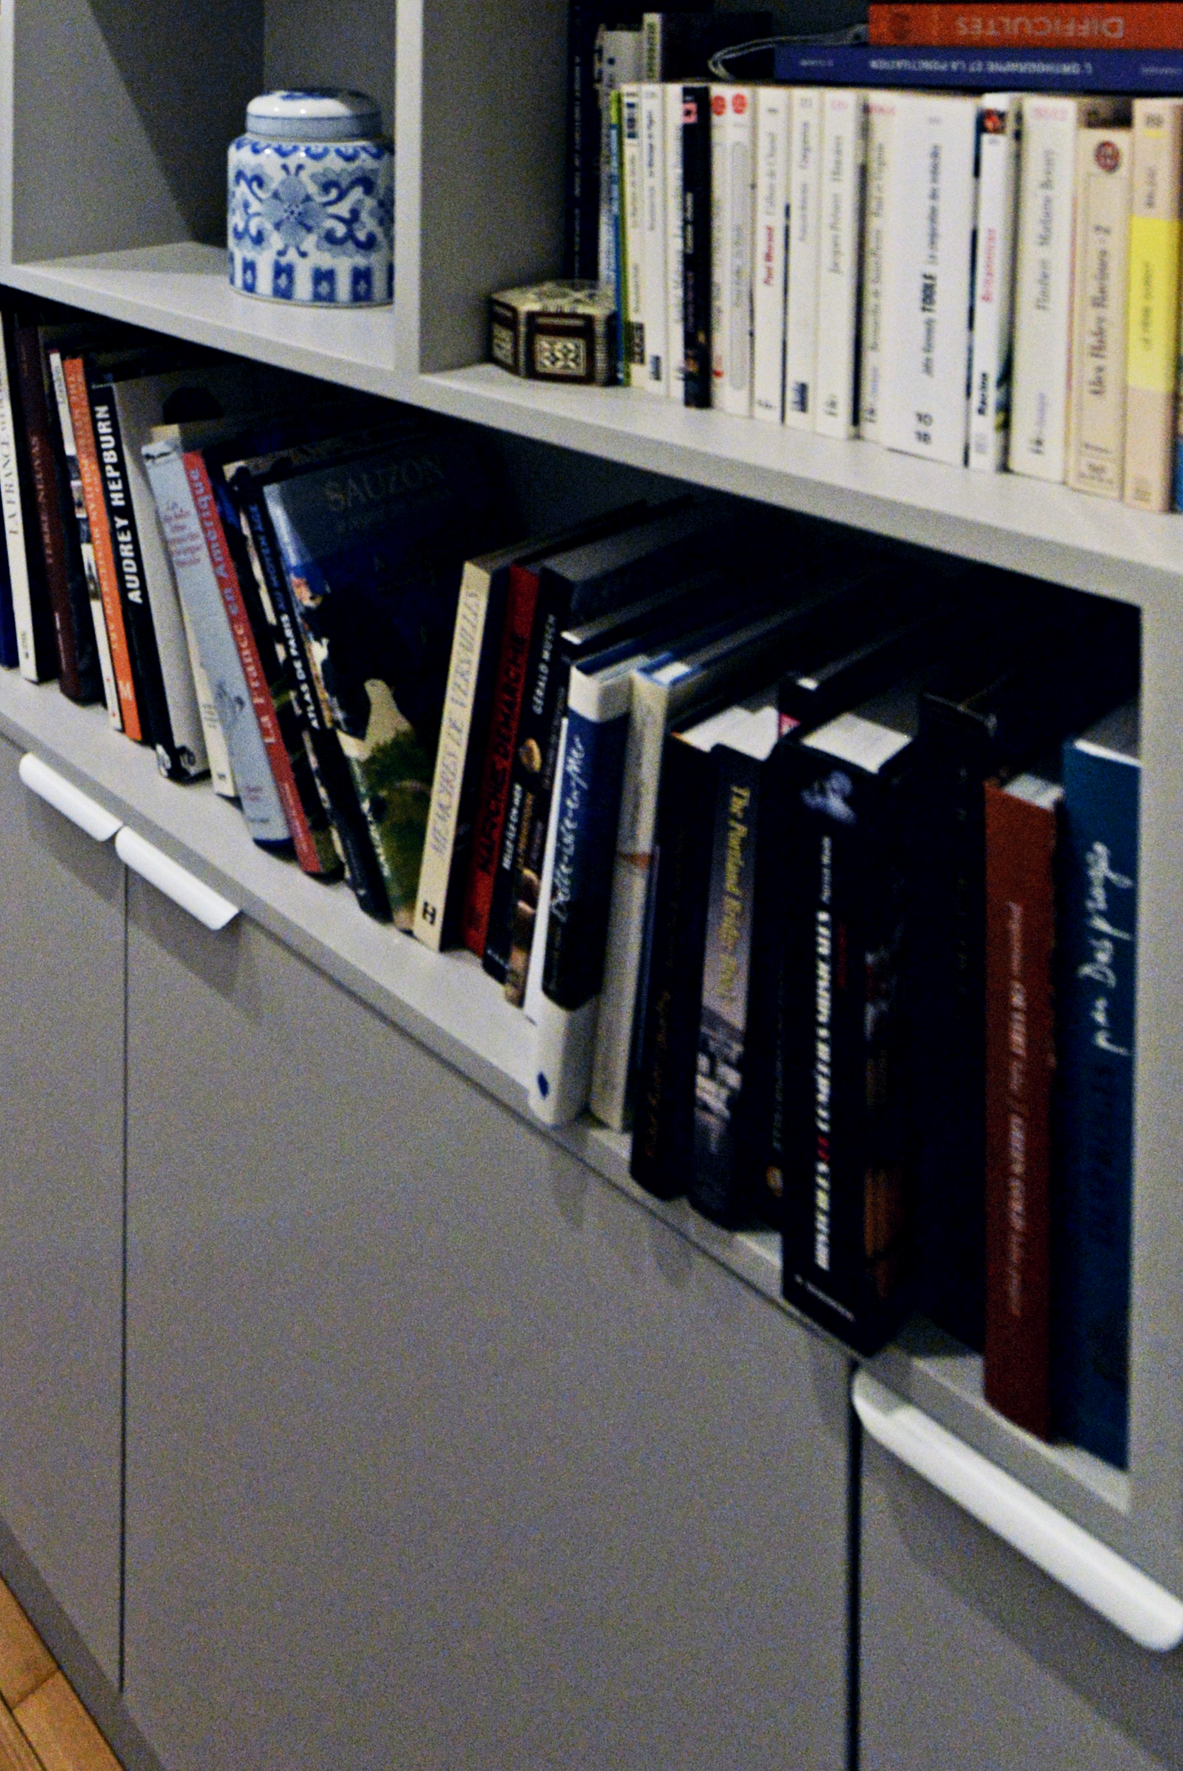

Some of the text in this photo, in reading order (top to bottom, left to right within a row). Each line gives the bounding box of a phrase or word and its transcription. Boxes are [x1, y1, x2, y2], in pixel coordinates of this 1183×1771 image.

[763, 225, 775, 260] Morand
[763, 262, 775, 286] Paul
[922, 272, 936, 314] TOOLE
[977, 371, 990, 417] Racine
[94, 404, 144, 604] AUDREY HEPBURN
[324, 453, 446, 512] SAUZON
[258, 536, 281, 587] MOYEN
[188, 467, 277, 744] La France en Amérique
[280, 613, 300, 657] PARIS
[291, 658, 305, 680] DE
[300, 682, 321, 730] ATLAS
[729, 784, 752, 819] The
[724, 820, 749, 895] Portland
